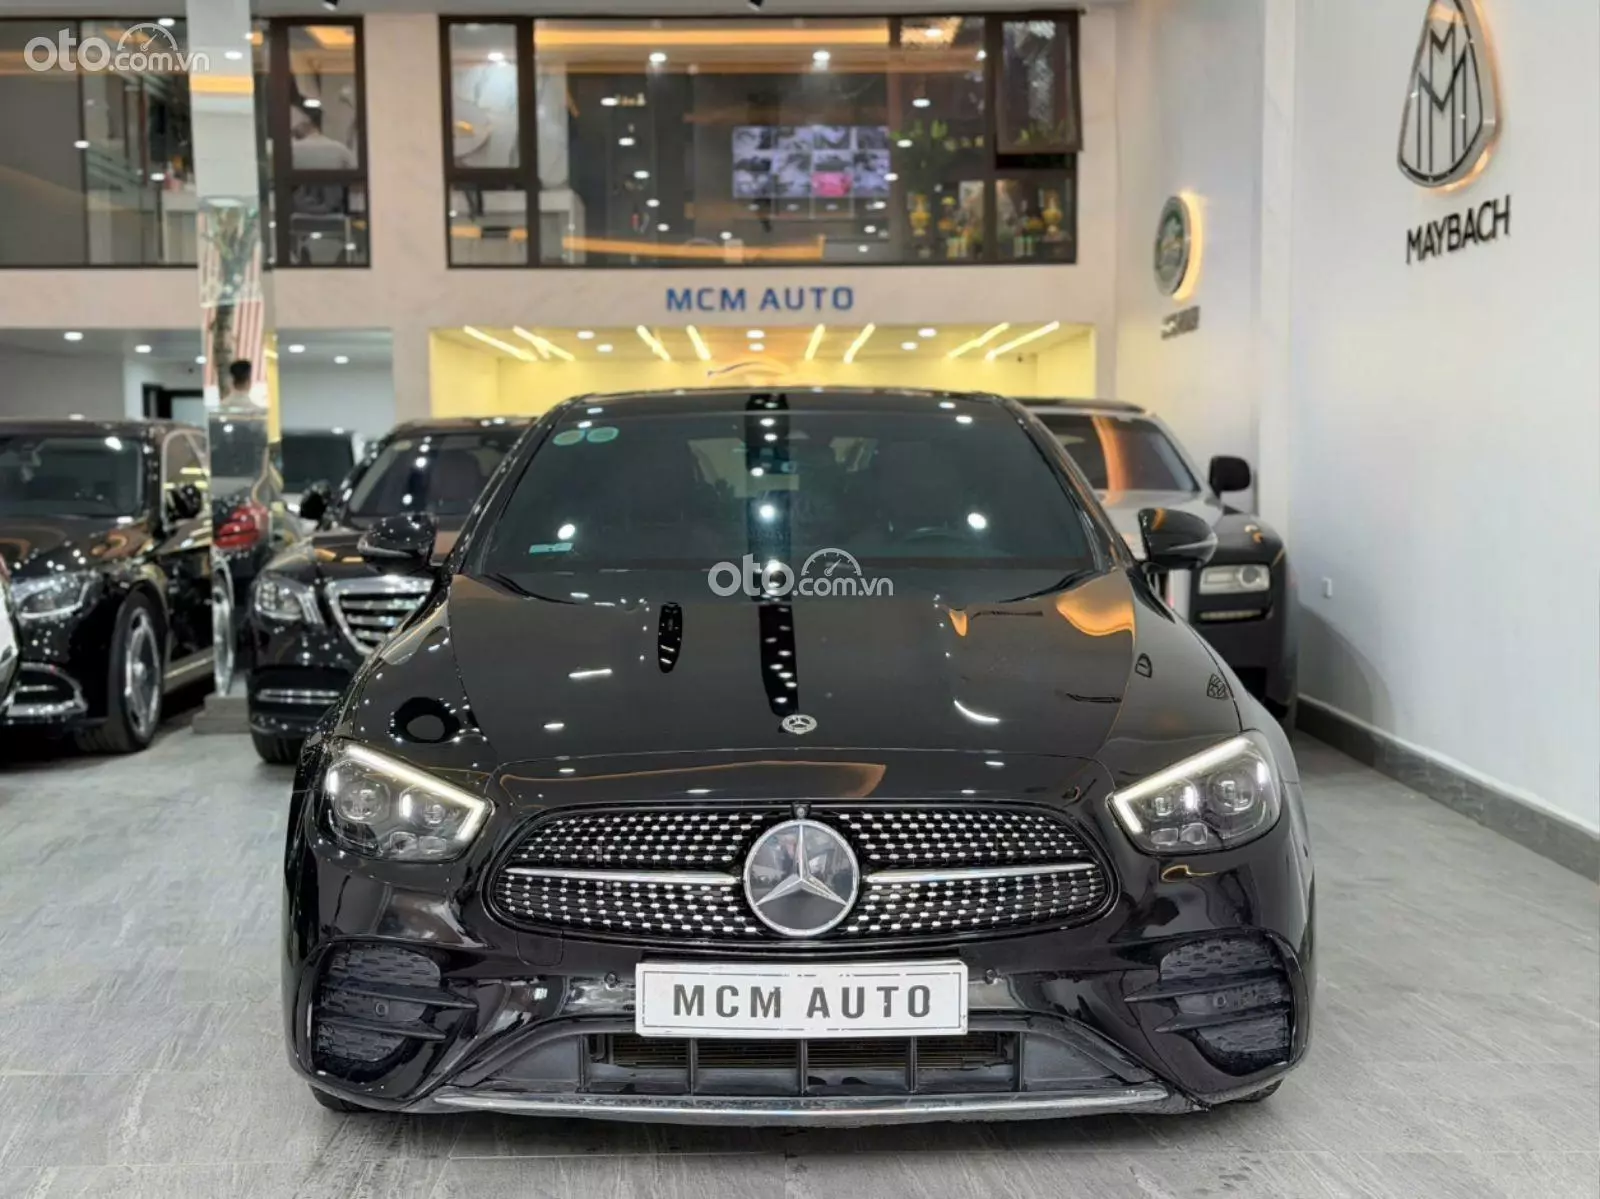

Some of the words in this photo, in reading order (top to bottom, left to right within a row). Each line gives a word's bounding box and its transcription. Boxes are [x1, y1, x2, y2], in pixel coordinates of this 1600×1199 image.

[1406, 194, 1511, 265] MAYBACH
[666, 287, 746, 312] MCM
[759, 286, 854, 312] AUTO
[673, 983, 782, 1018] MCM
[806, 984, 931, 1018] AUTO
